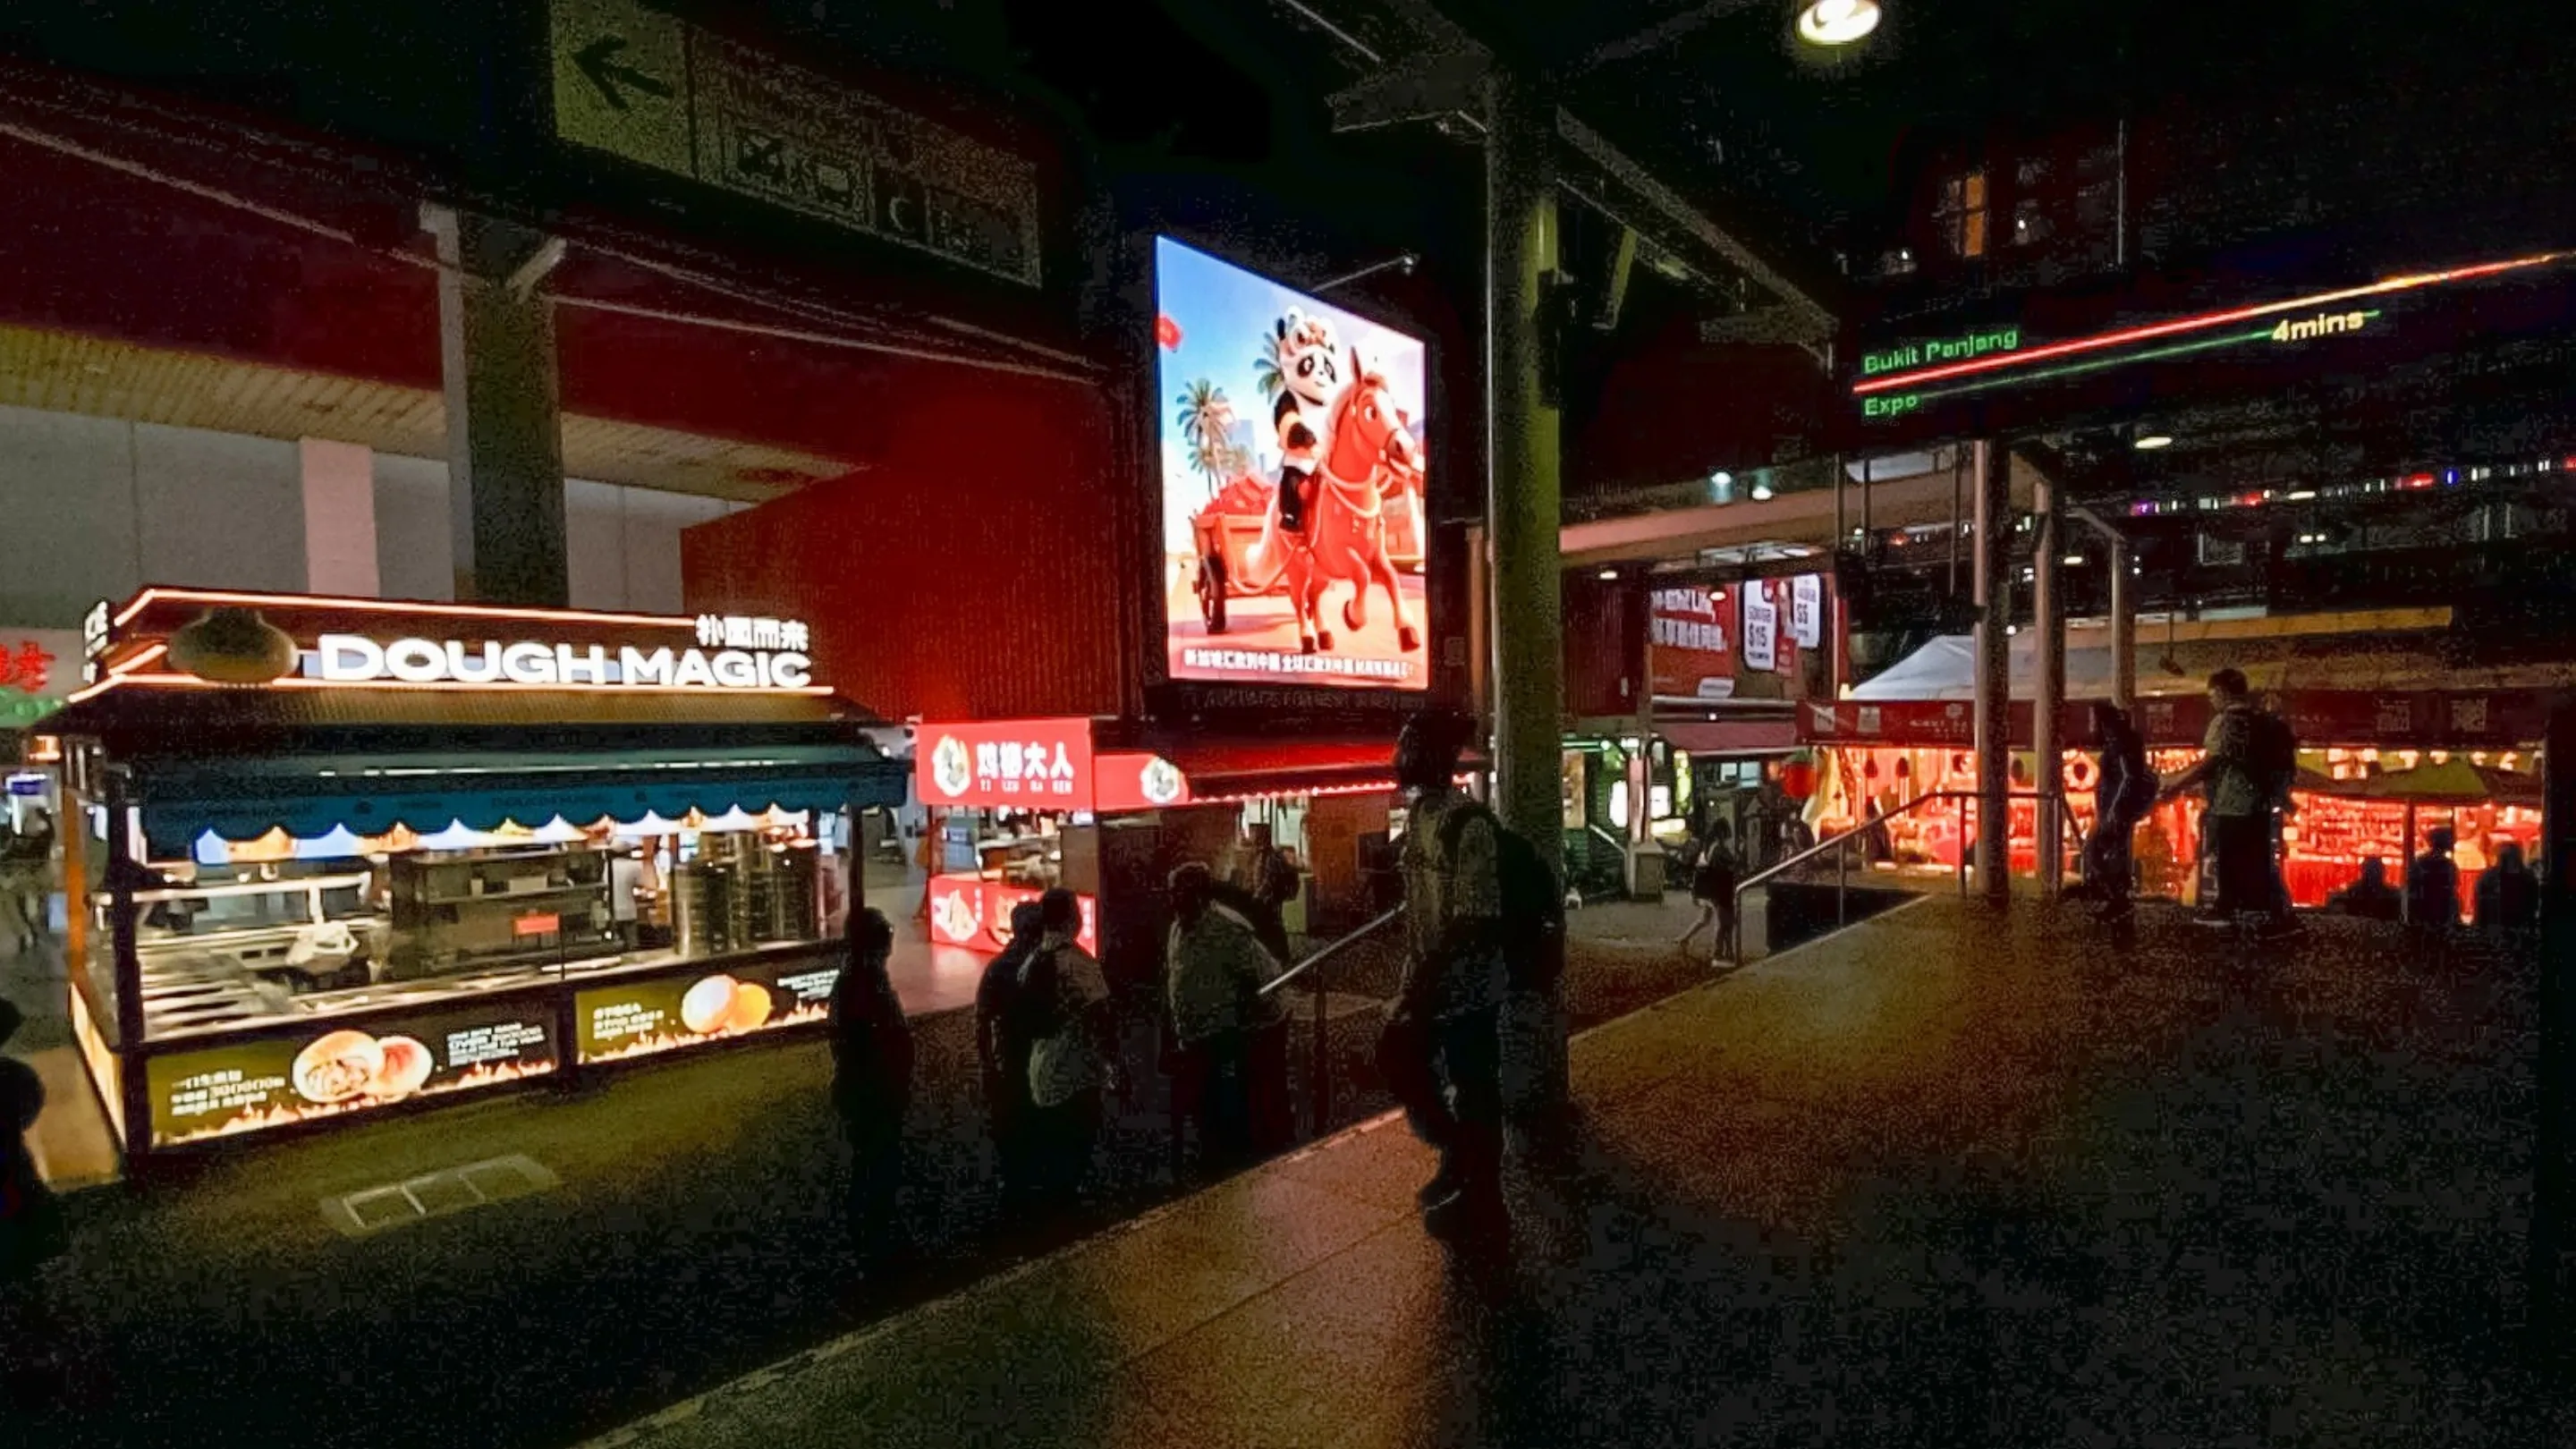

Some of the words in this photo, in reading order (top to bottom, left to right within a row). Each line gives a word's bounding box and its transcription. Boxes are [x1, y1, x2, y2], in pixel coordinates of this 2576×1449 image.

[2271, 309, 2364, 343] 4mins
[1863, 345, 1919, 375] Bukit
[1925, 331, 2018, 363] Panjang
[1864, 394, 1920, 420] Expo
[318, 633, 607, 685] DOUGH
[621, 647, 811, 689] MAGIC
